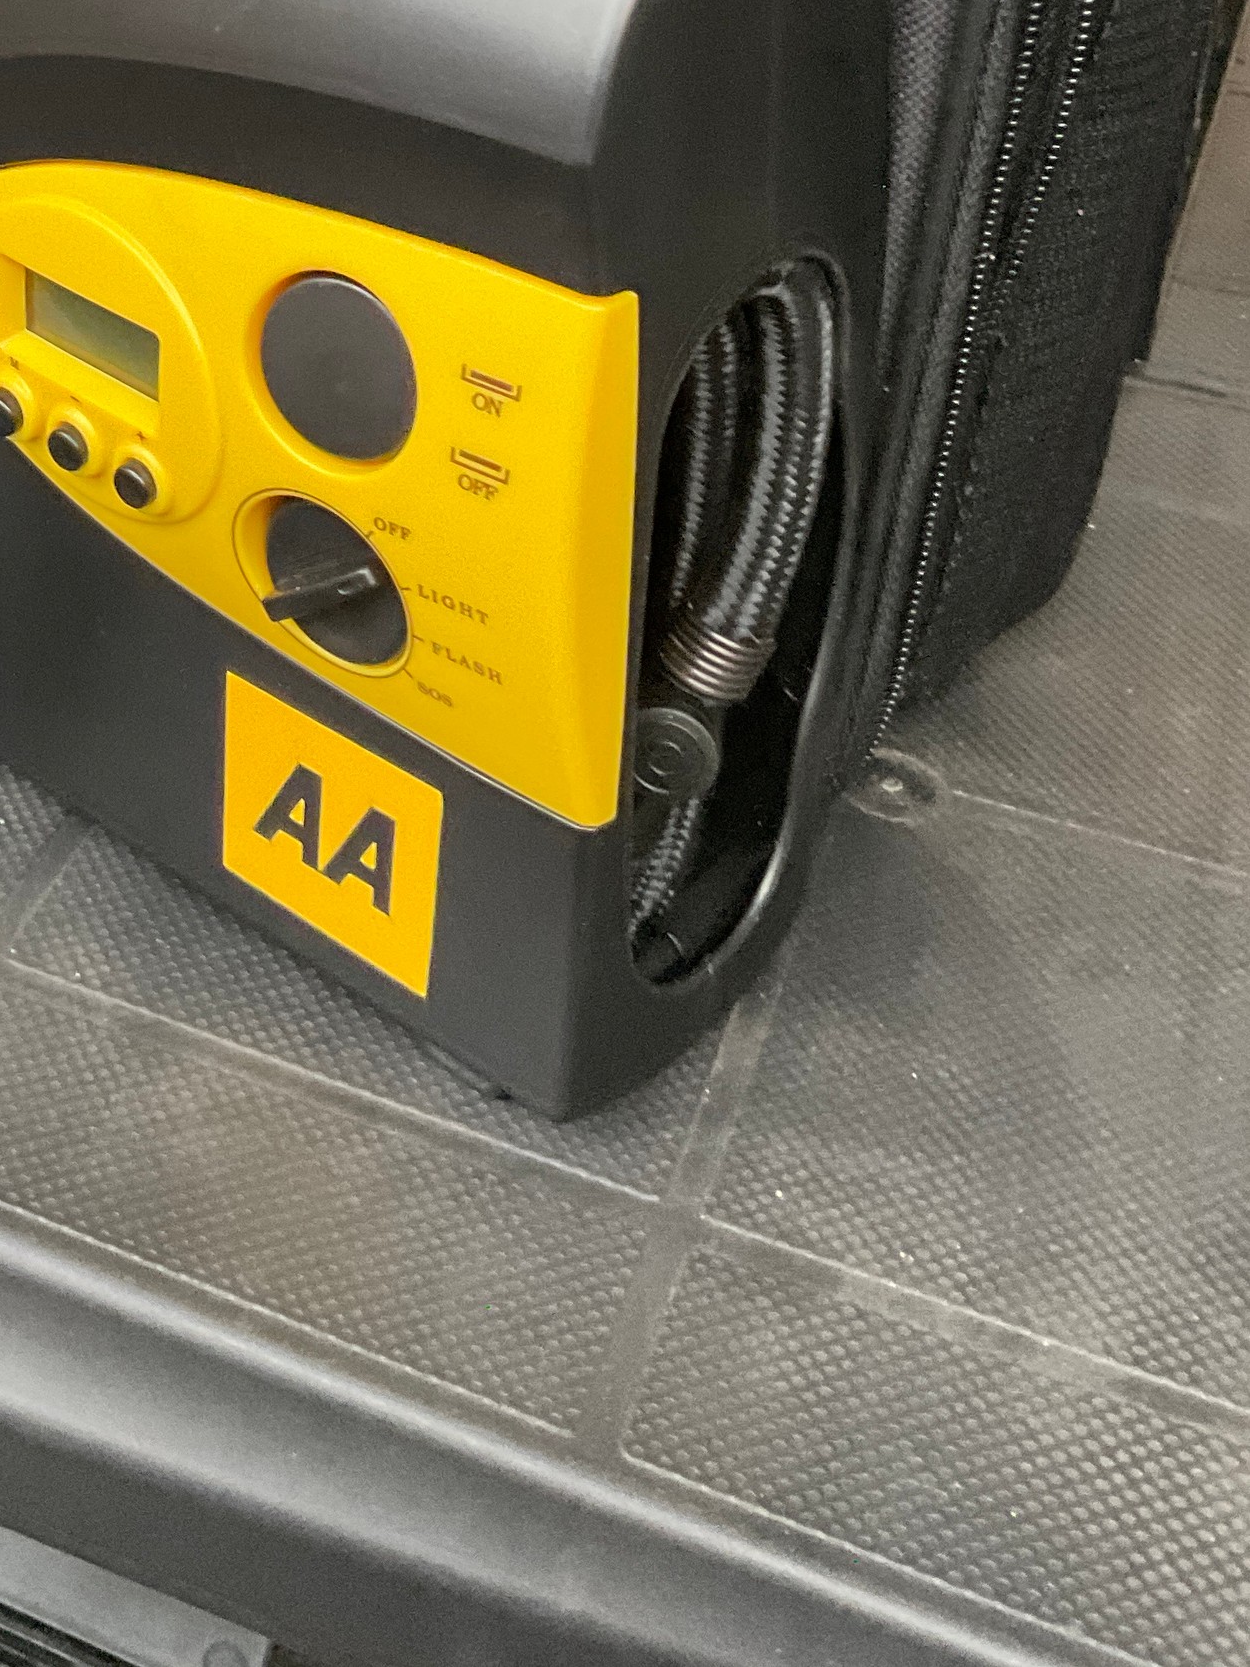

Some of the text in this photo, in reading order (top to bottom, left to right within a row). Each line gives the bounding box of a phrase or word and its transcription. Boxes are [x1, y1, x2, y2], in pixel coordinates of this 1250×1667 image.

[471, 393, 504, 418] ON
[457, 474, 499, 502] OFF
[373, 516, 412, 541] OFF
[417, 584, 490, 626] LIGHT
[431, 642, 504, 686] FLASH
[417, 681, 454, 708] SOS
[253, 762, 396, 917] AA
